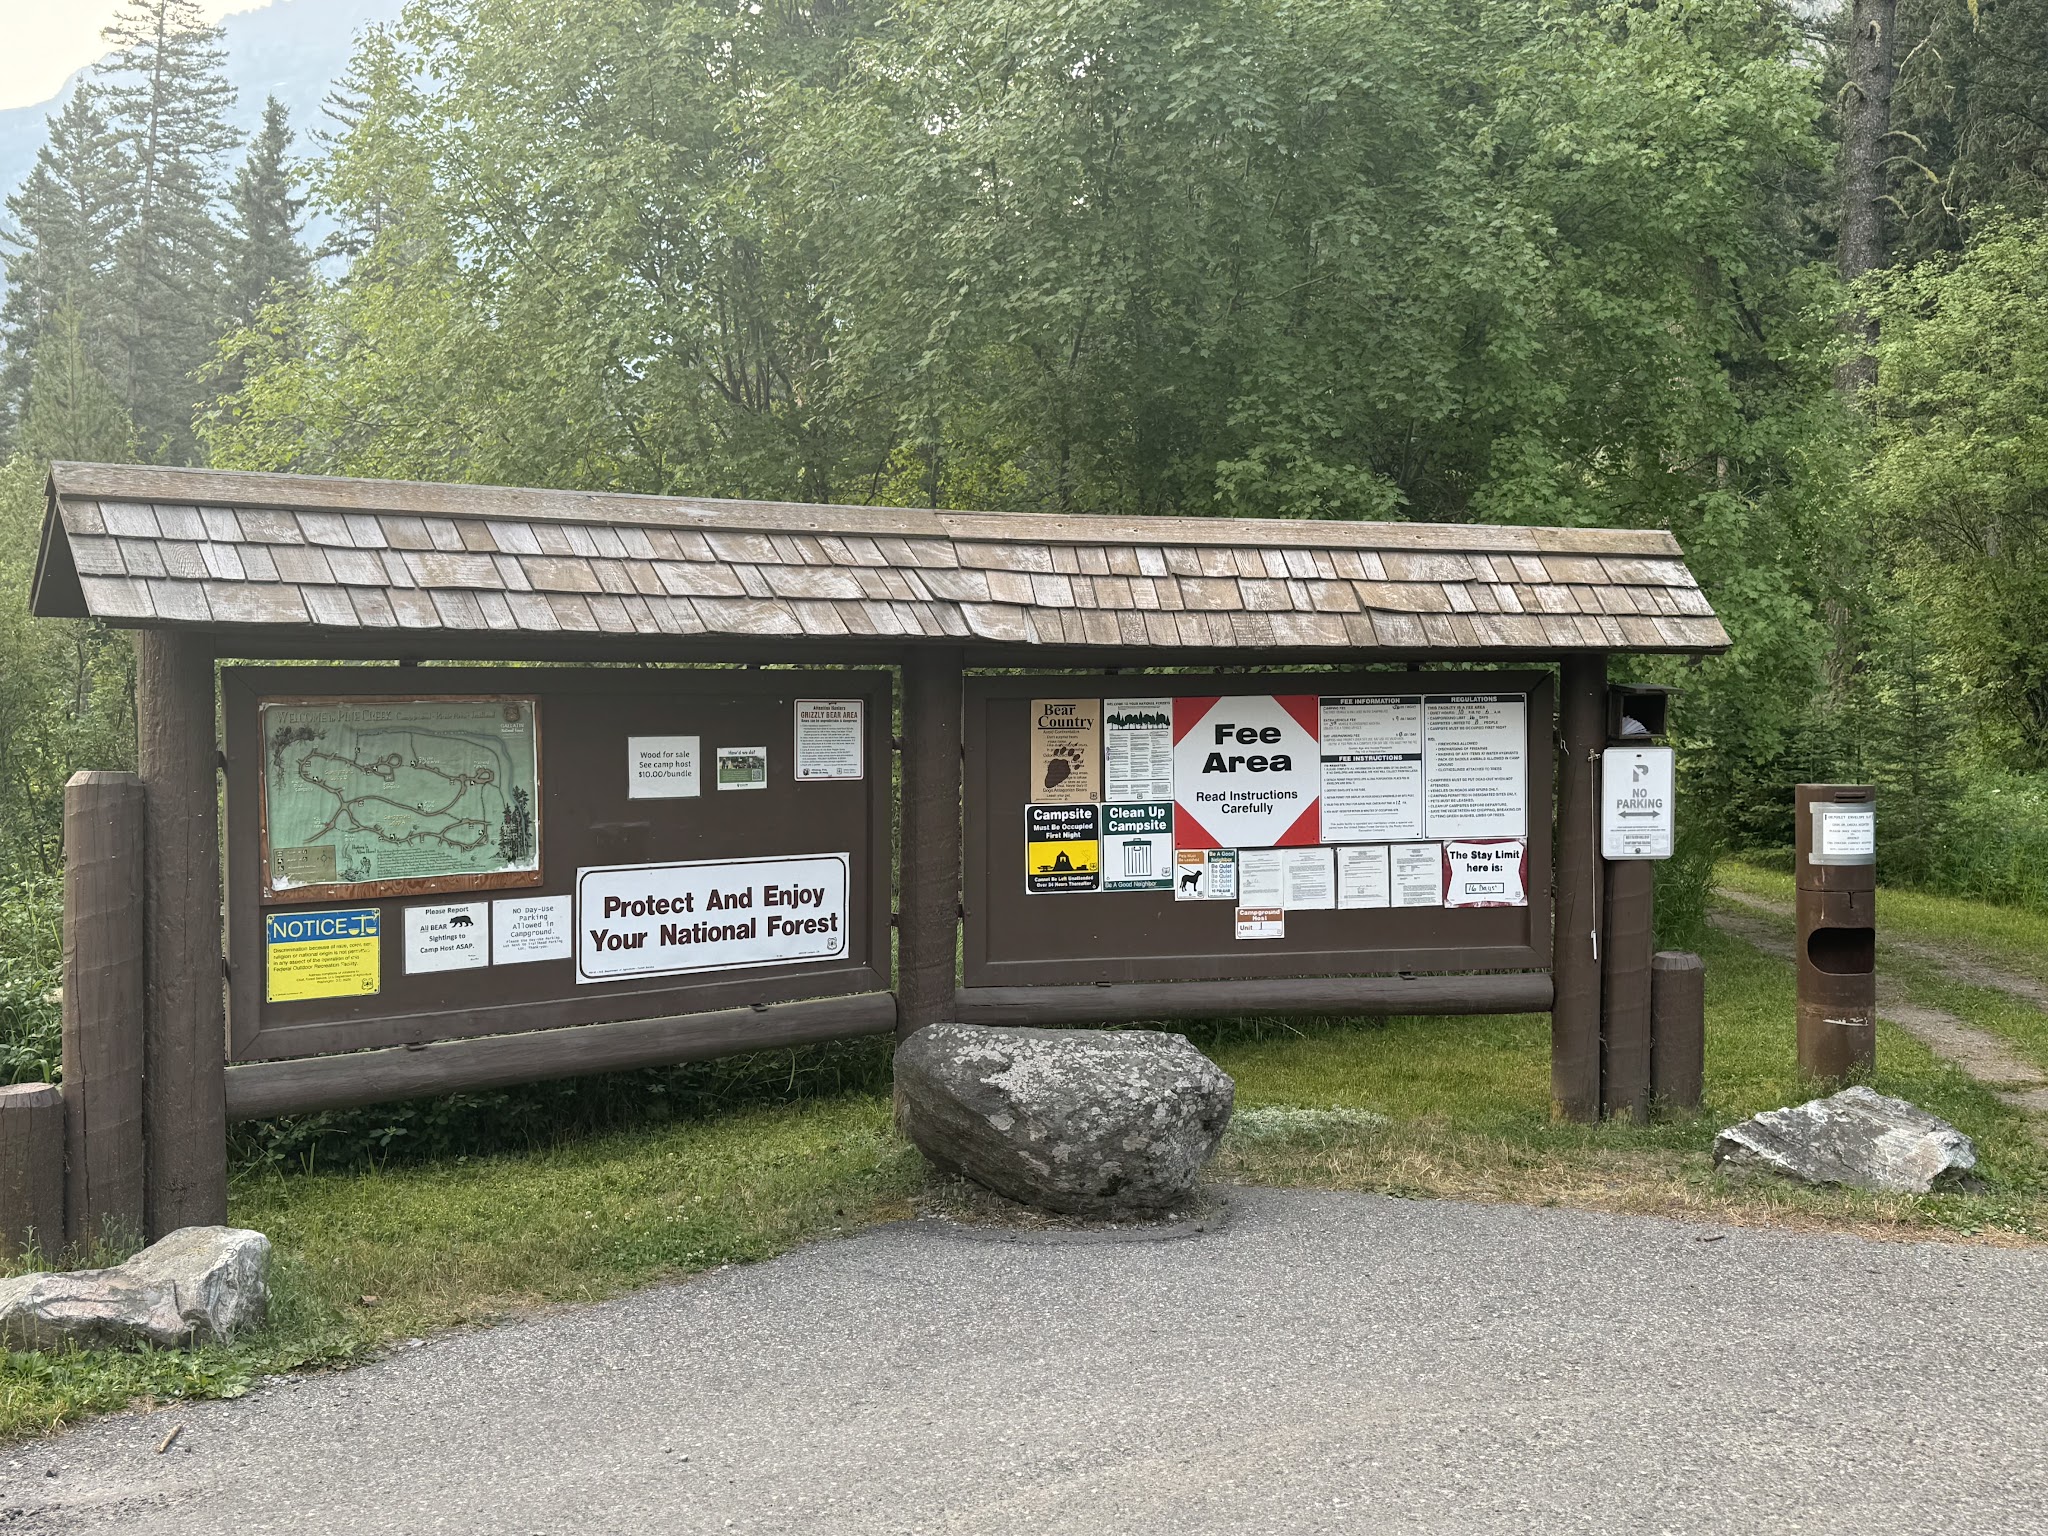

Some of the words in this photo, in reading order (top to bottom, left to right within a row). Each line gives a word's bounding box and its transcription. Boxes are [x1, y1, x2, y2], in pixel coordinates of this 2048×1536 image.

[1044, 704, 1075, 715] Bear
[1038, 716, 1094, 730] Country
[1215, 724, 1281, 745] Fee
[1202, 752, 1292, 773] Area
[639, 770, 692, 778] $10.00/bundle
[1196, 791, 1225, 802] Read
[1230, 790, 1298, 801] Instructions
[1632, 789, 1647, 798] NO
[1222, 803, 1273, 815] Carefully
[1617, 799, 1662, 808] PARKING
[1034, 808, 1092, 822] Campsite
[1110, 807, 1144, 818] Clean
[1148, 806, 1165, 818] Up
[1109, 820, 1166, 833] Campsite
[1450, 851, 1468, 859] The
[1471, 851, 1492, 861] Stay
[1496, 850, 1520, 859] Limit
[1467, 863, 1488, 872] here
[1492, 863, 1503, 872] is:
[604, 892, 694, 918] Protect
[706, 887, 752, 911] And
[764, 884, 825, 909] Enjoy
[525, 906, 554, 914] Day-Use
[274, 918, 347, 938] NOTICE
[513, 922, 541, 930] Allowed
[590, 929, 648, 951] Your
[660, 918, 756, 947] National
[768, 913, 838, 937] Forest
[429, 934, 457, 942] Sightings
[511, 929, 555, 937] Campground.
